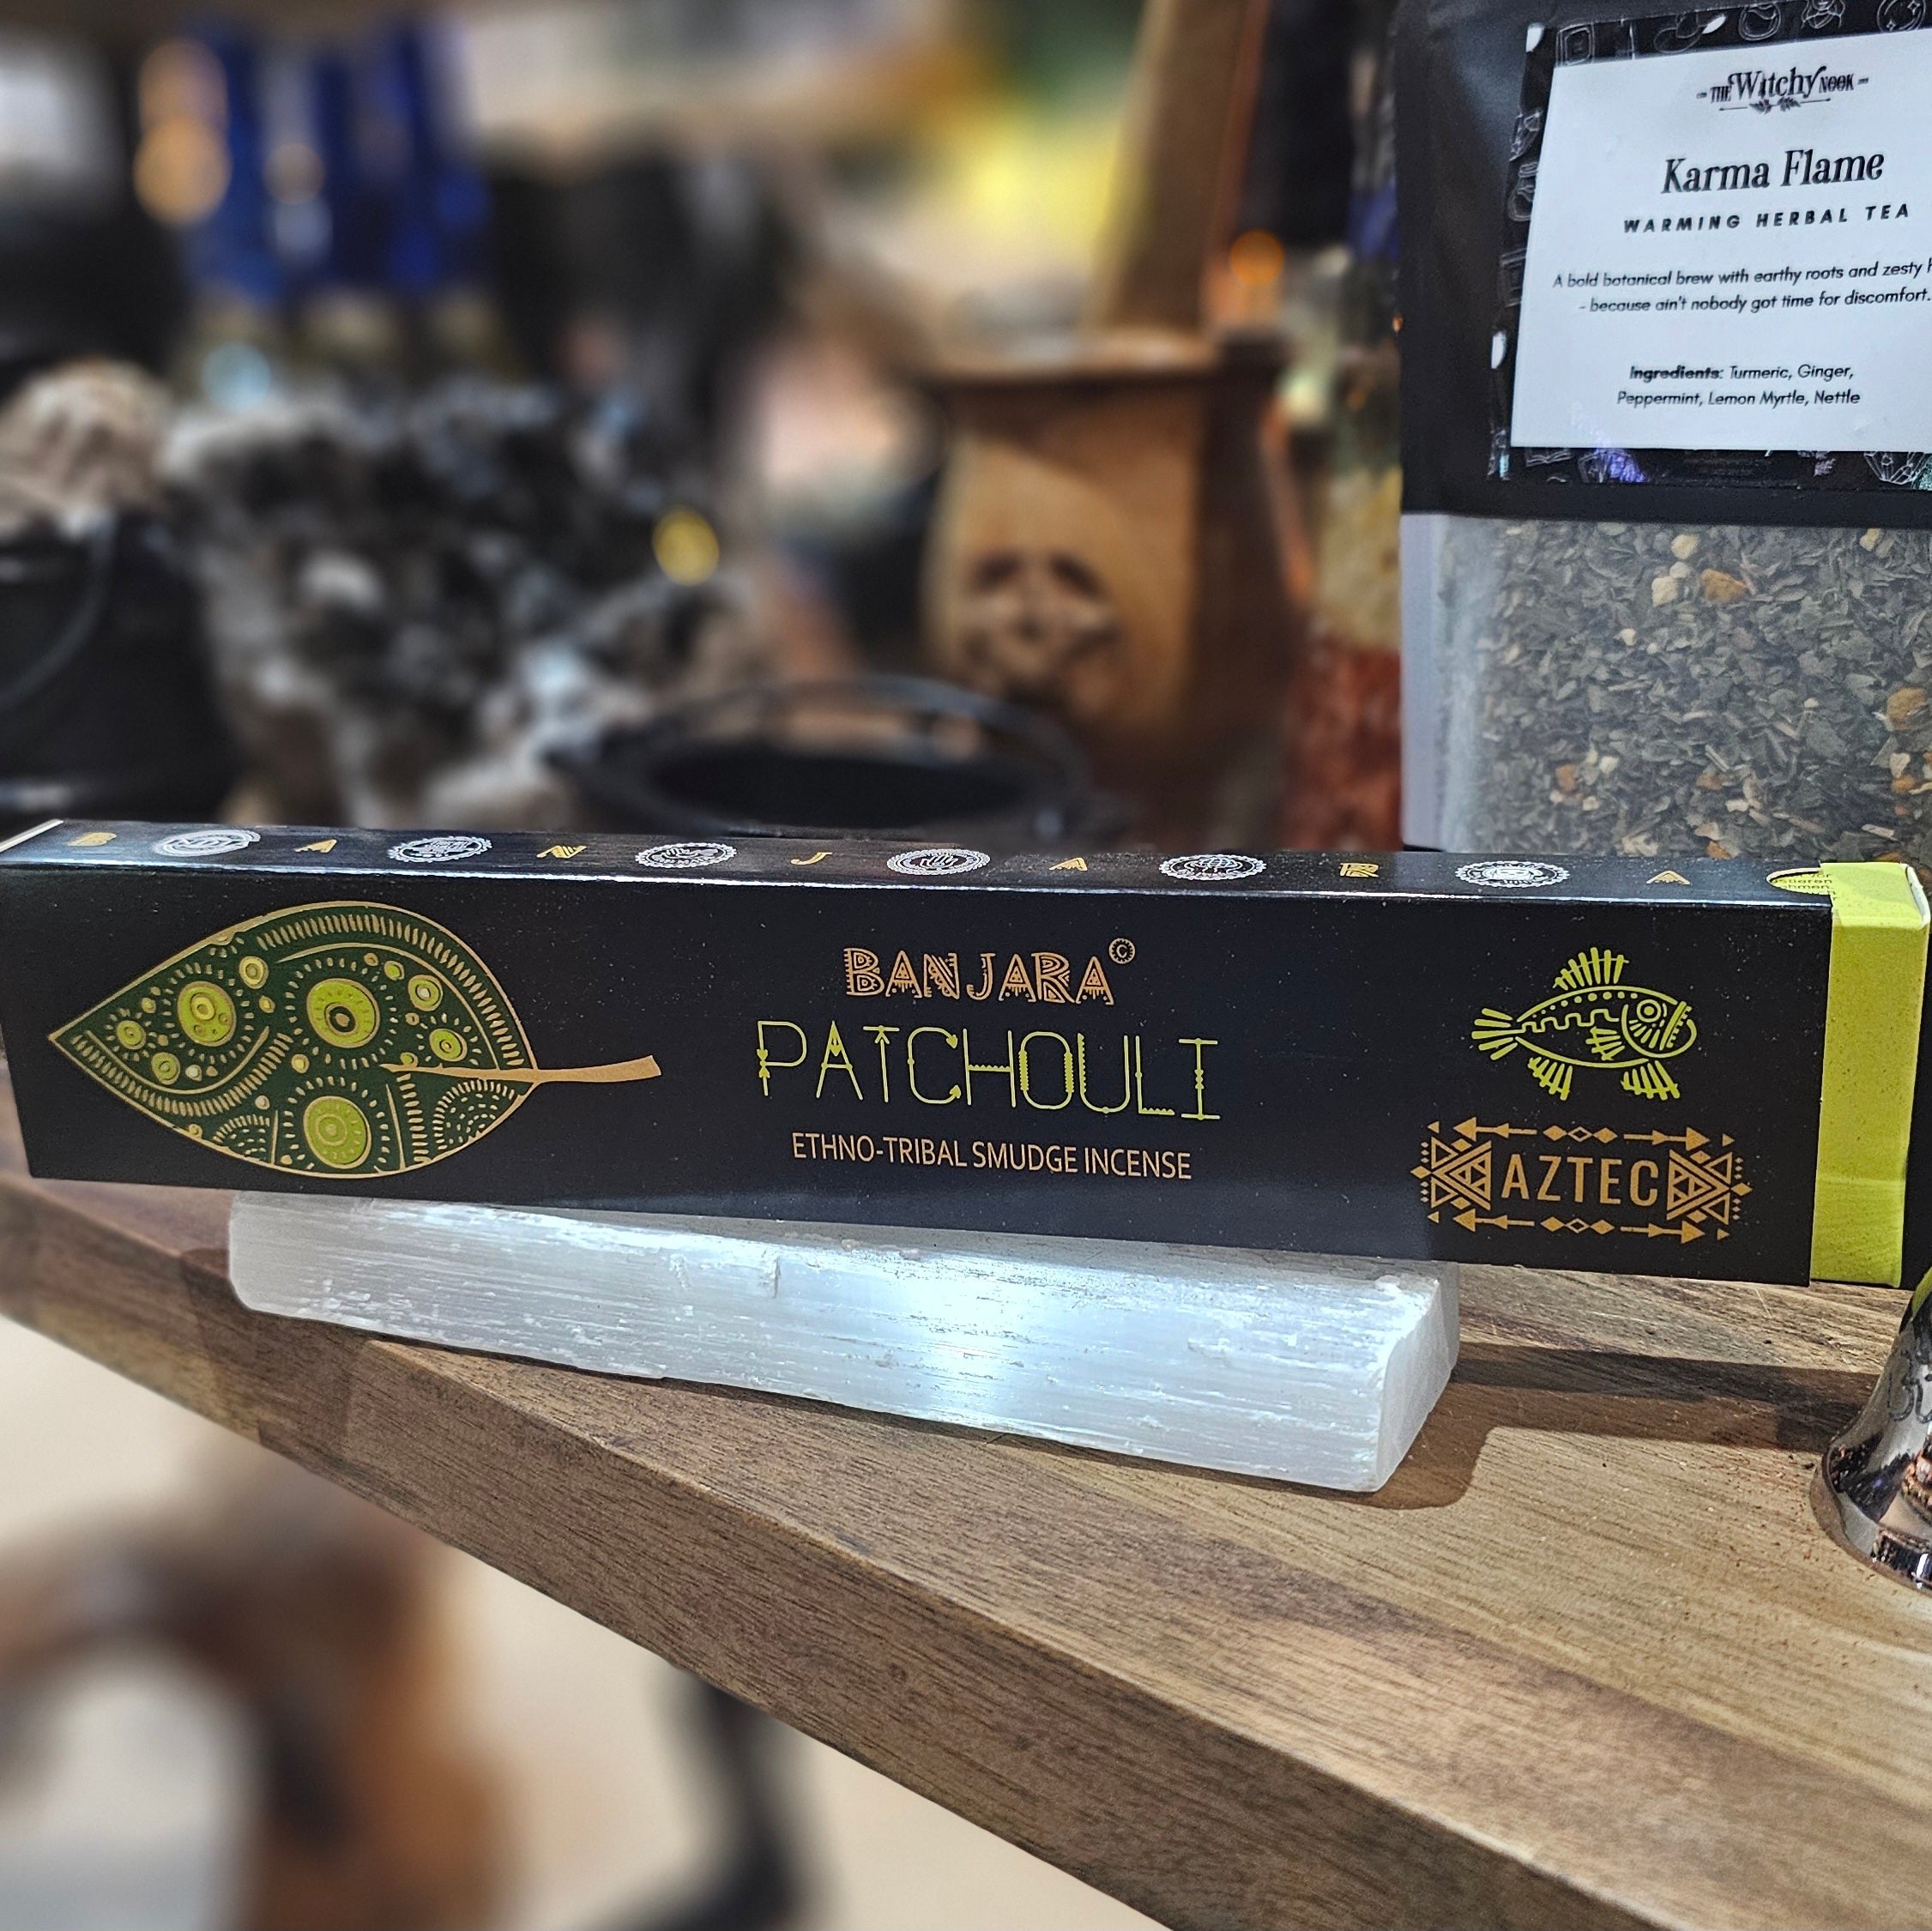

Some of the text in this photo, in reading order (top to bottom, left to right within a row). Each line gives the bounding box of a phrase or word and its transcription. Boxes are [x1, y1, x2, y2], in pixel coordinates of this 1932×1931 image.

[1711, 65, 1855, 103] THE Witchy NOOK
[1660, 148, 1885, 195] Karma Flame
[1623, 202, 1909, 233] WARMING HERBAL TEA
[1553, 274, 1563, 287] A
[1567, 271, 1599, 288] bold
[1603, 269, 1673, 287] botanical
[1675, 269, 1715, 286] brew
[1718, 268, 1749, 285] with
[1754, 265, 1802, 287] earthy
[1805, 265, 1844, 281] roots
[1848, 260, 1880, 279] and
[1881, 261, 1924, 280] zesty
[1590, 297, 1651, 312] because
[1655, 295, 1688, 311] ain't
[1690, 293, 1748, 314] nobody
[1749, 297, 1778, 314] got
[1781, 294, 1814, 308] time
[1818, 290, 1842, 306] for
[1844, 286, 1932, 305] discomfort.
[1628, 363, 1854, 383] Ingredients: Turmeric, Ginger,
[1616, 388, 1861, 410] Peppermint, Lemon Myrtle, Nettle
[843, 947, 1114, 1005] BANJARA
[756, 1020, 1220, 1119] PATCHOULI
[792, 1131, 1192, 1180] ETHNO-TRIBAL SMUDGE INCENSE
[1502, 1153, 1658, 1207] AZTEC
